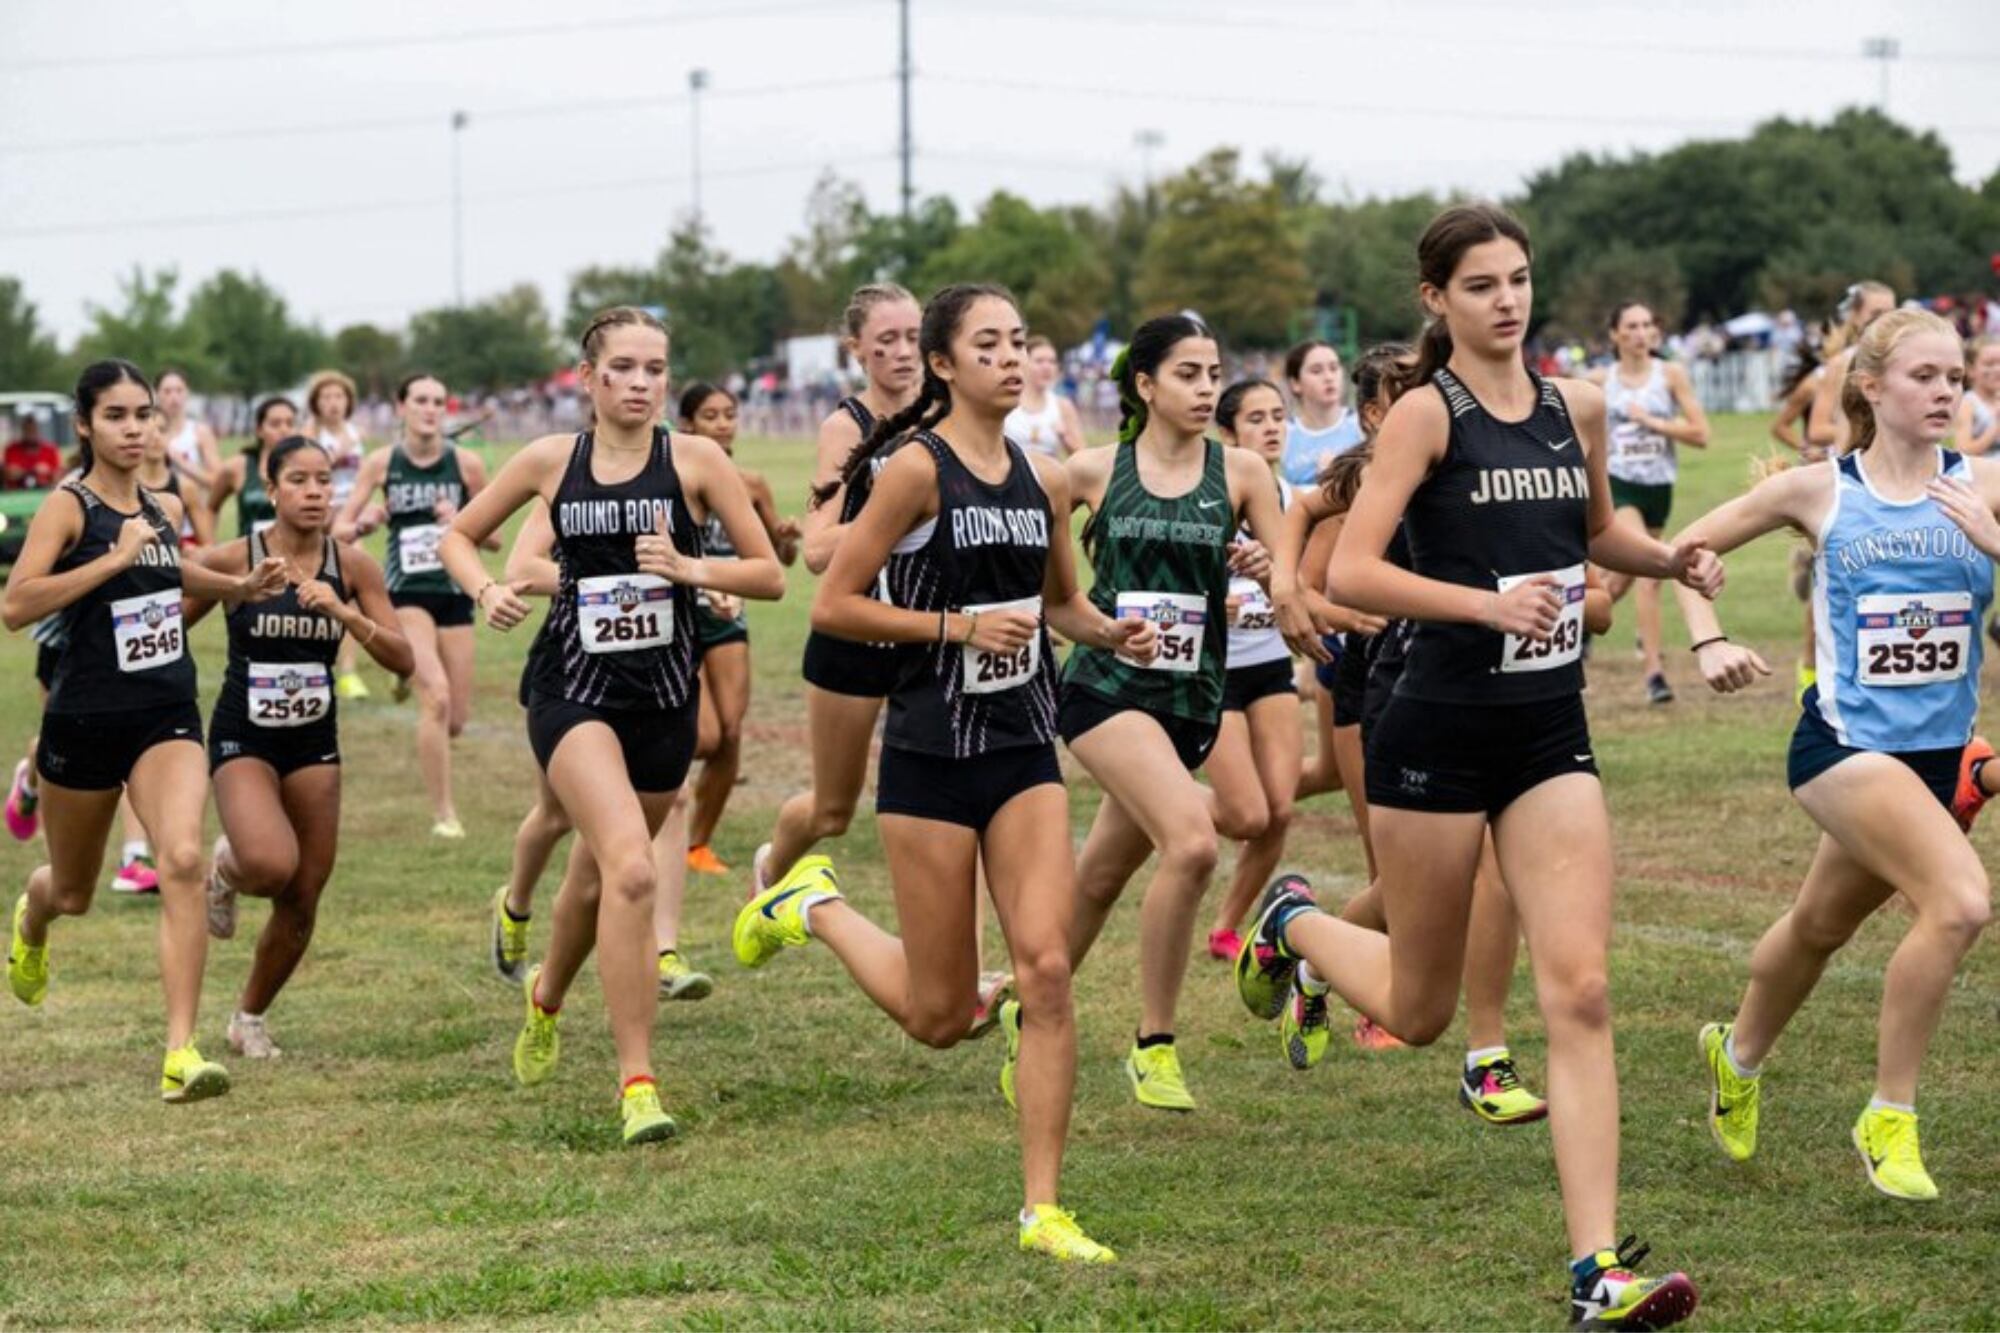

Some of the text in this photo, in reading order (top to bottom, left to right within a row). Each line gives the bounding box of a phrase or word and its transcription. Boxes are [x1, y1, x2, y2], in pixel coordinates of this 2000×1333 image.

[1470, 466, 1590, 505] JORDAN
[559, 501, 620, 538] ROUND
[250, 612, 343, 640] JORDAN
[595, 613, 659, 642] 2611
[1514, 618, 1578, 660] 2543
[126, 629, 179, 662] 2546
[1868, 641, 1960, 674] 2533
[977, 645, 1031, 682] 2614
[258, 697, 322, 719] 2542
